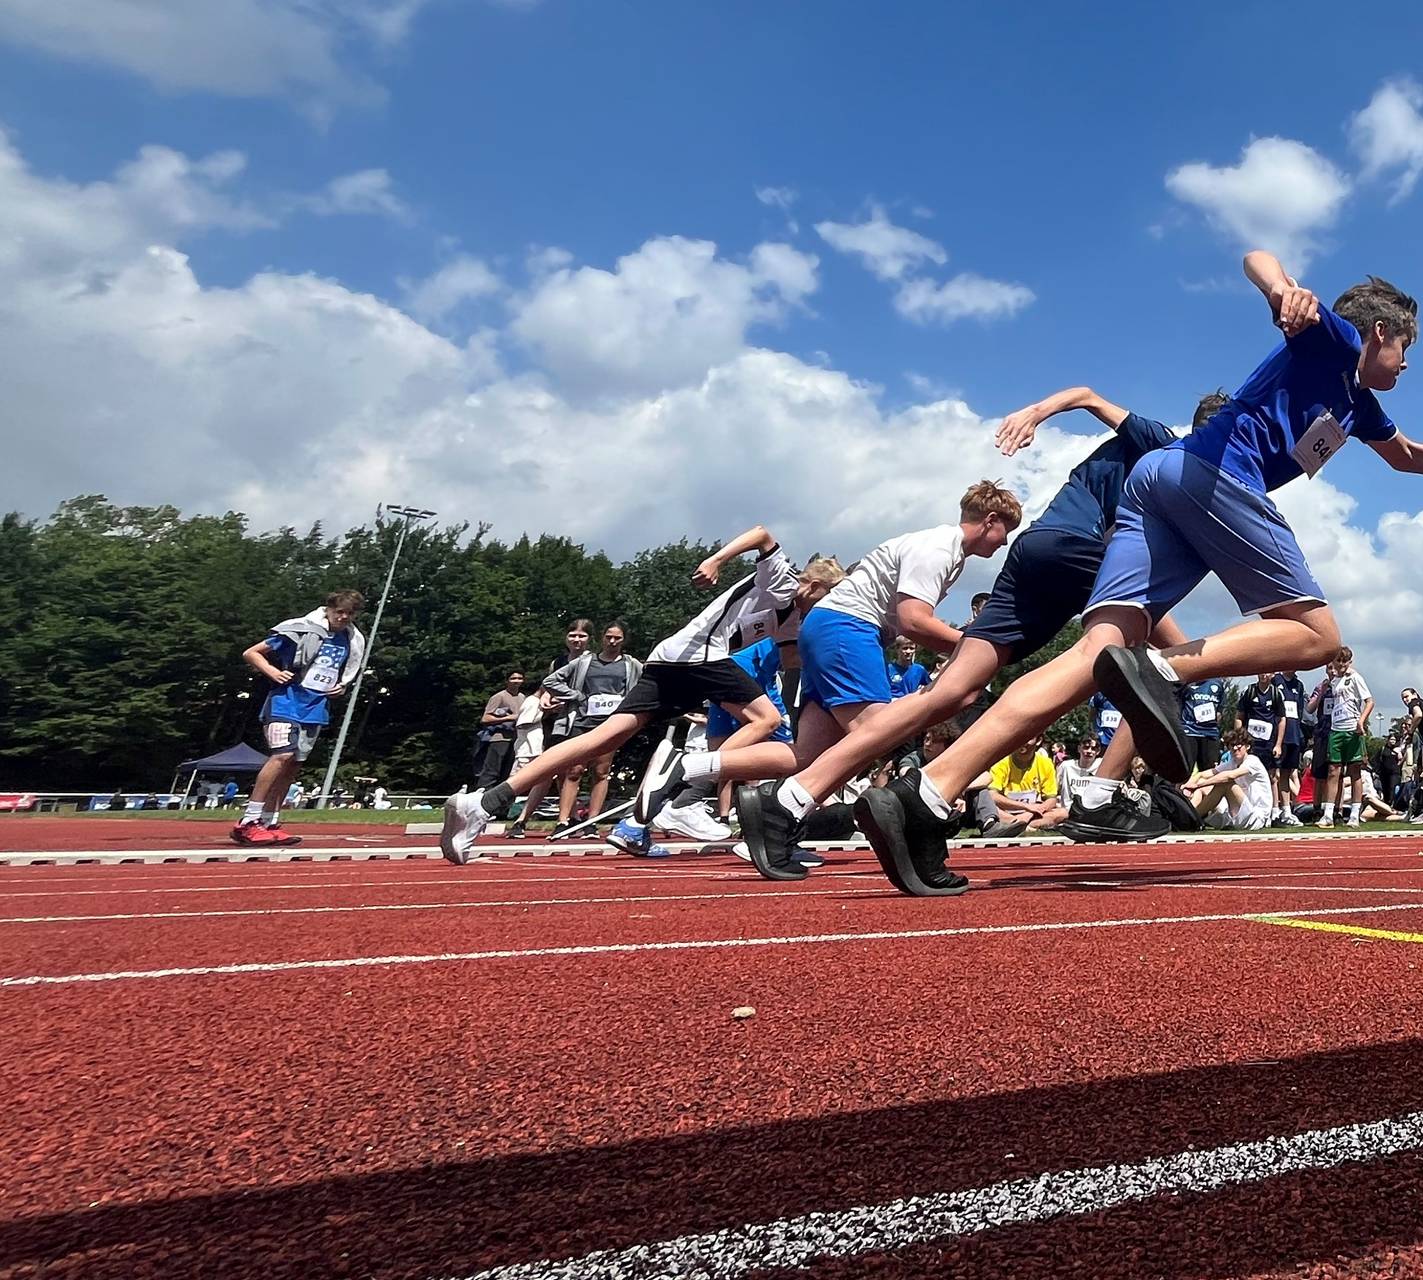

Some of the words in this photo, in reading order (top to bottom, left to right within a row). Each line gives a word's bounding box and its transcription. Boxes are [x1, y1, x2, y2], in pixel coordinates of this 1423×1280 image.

[1312, 438, 1333, 463] 84
[313, 673, 333, 685] 823
[594, 701, 614, 709] 840
[1070, 778, 1090, 788] PUM
